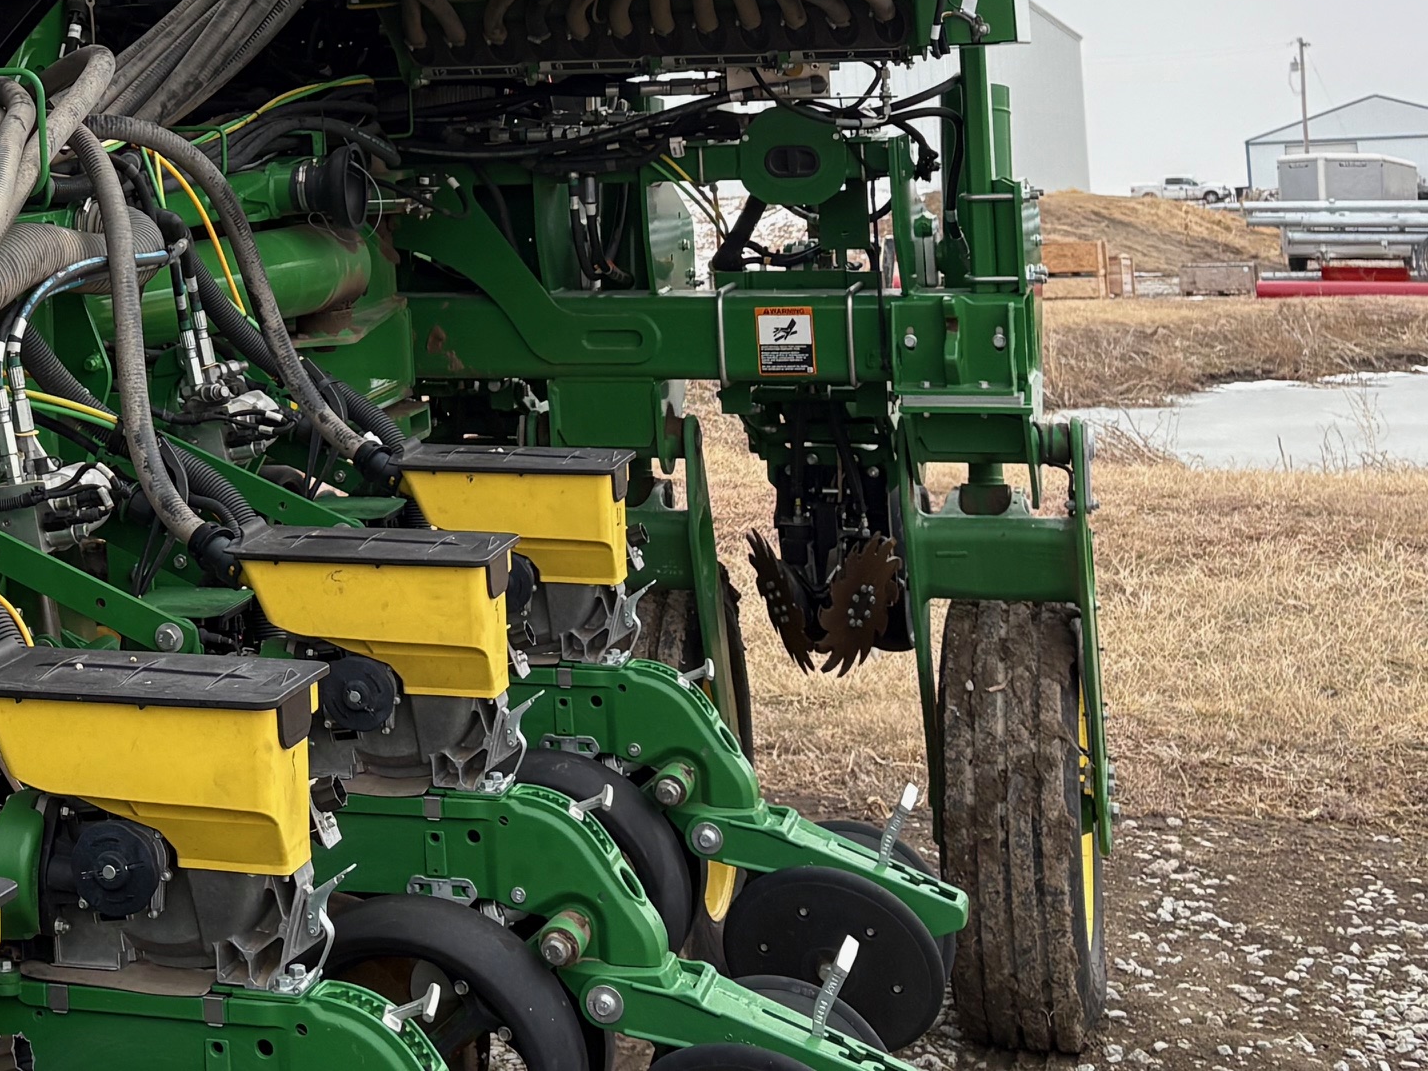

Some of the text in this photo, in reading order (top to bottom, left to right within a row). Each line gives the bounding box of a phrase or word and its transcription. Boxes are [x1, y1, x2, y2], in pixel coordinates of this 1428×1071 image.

[555, 63, 564, 71] 9
[434, 67, 518, 77] 12 11 10
